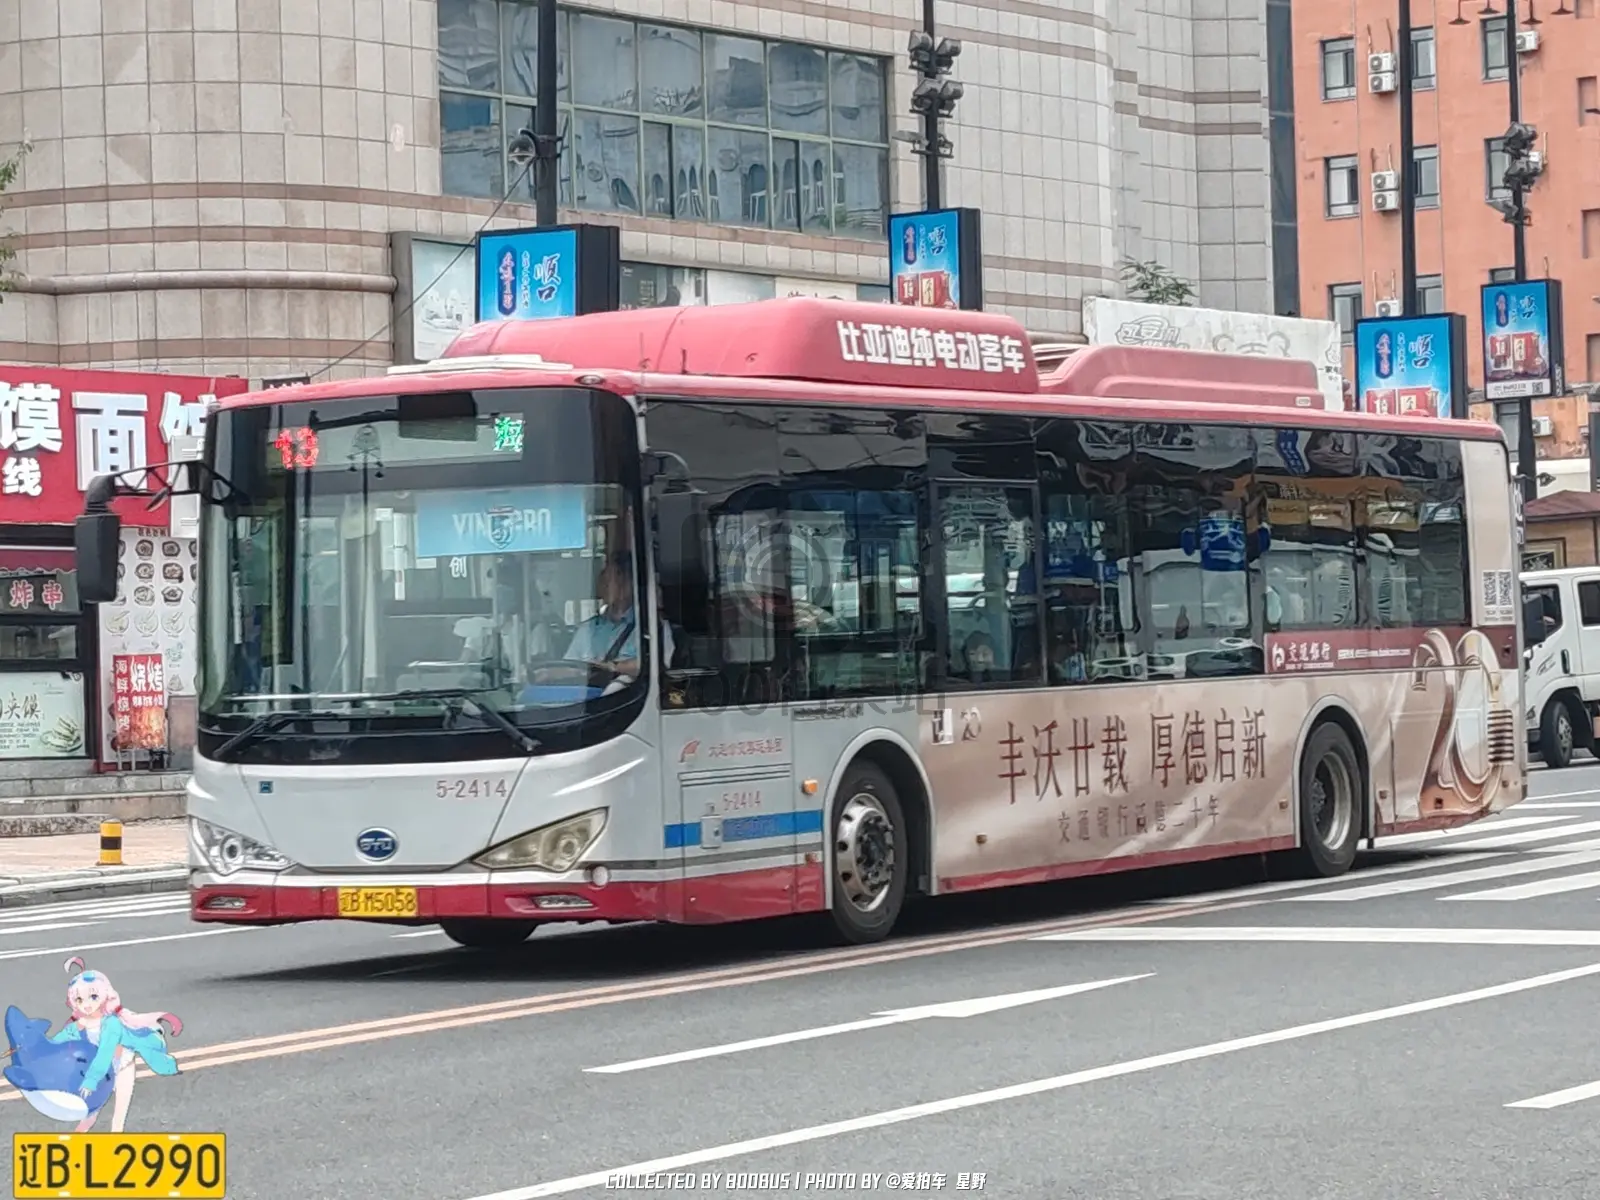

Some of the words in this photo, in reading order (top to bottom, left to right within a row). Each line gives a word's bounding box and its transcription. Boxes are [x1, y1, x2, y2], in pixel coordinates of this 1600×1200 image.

[836, 320, 1026, 374] 比亚迪纯电动客车
[2, 457, 43, 496] 线
[997, 715, 1130, 804] 丰沃廿载
[1150, 707, 1268, 788] 厚德启新
[435, 779, 508, 799] 5-2414
